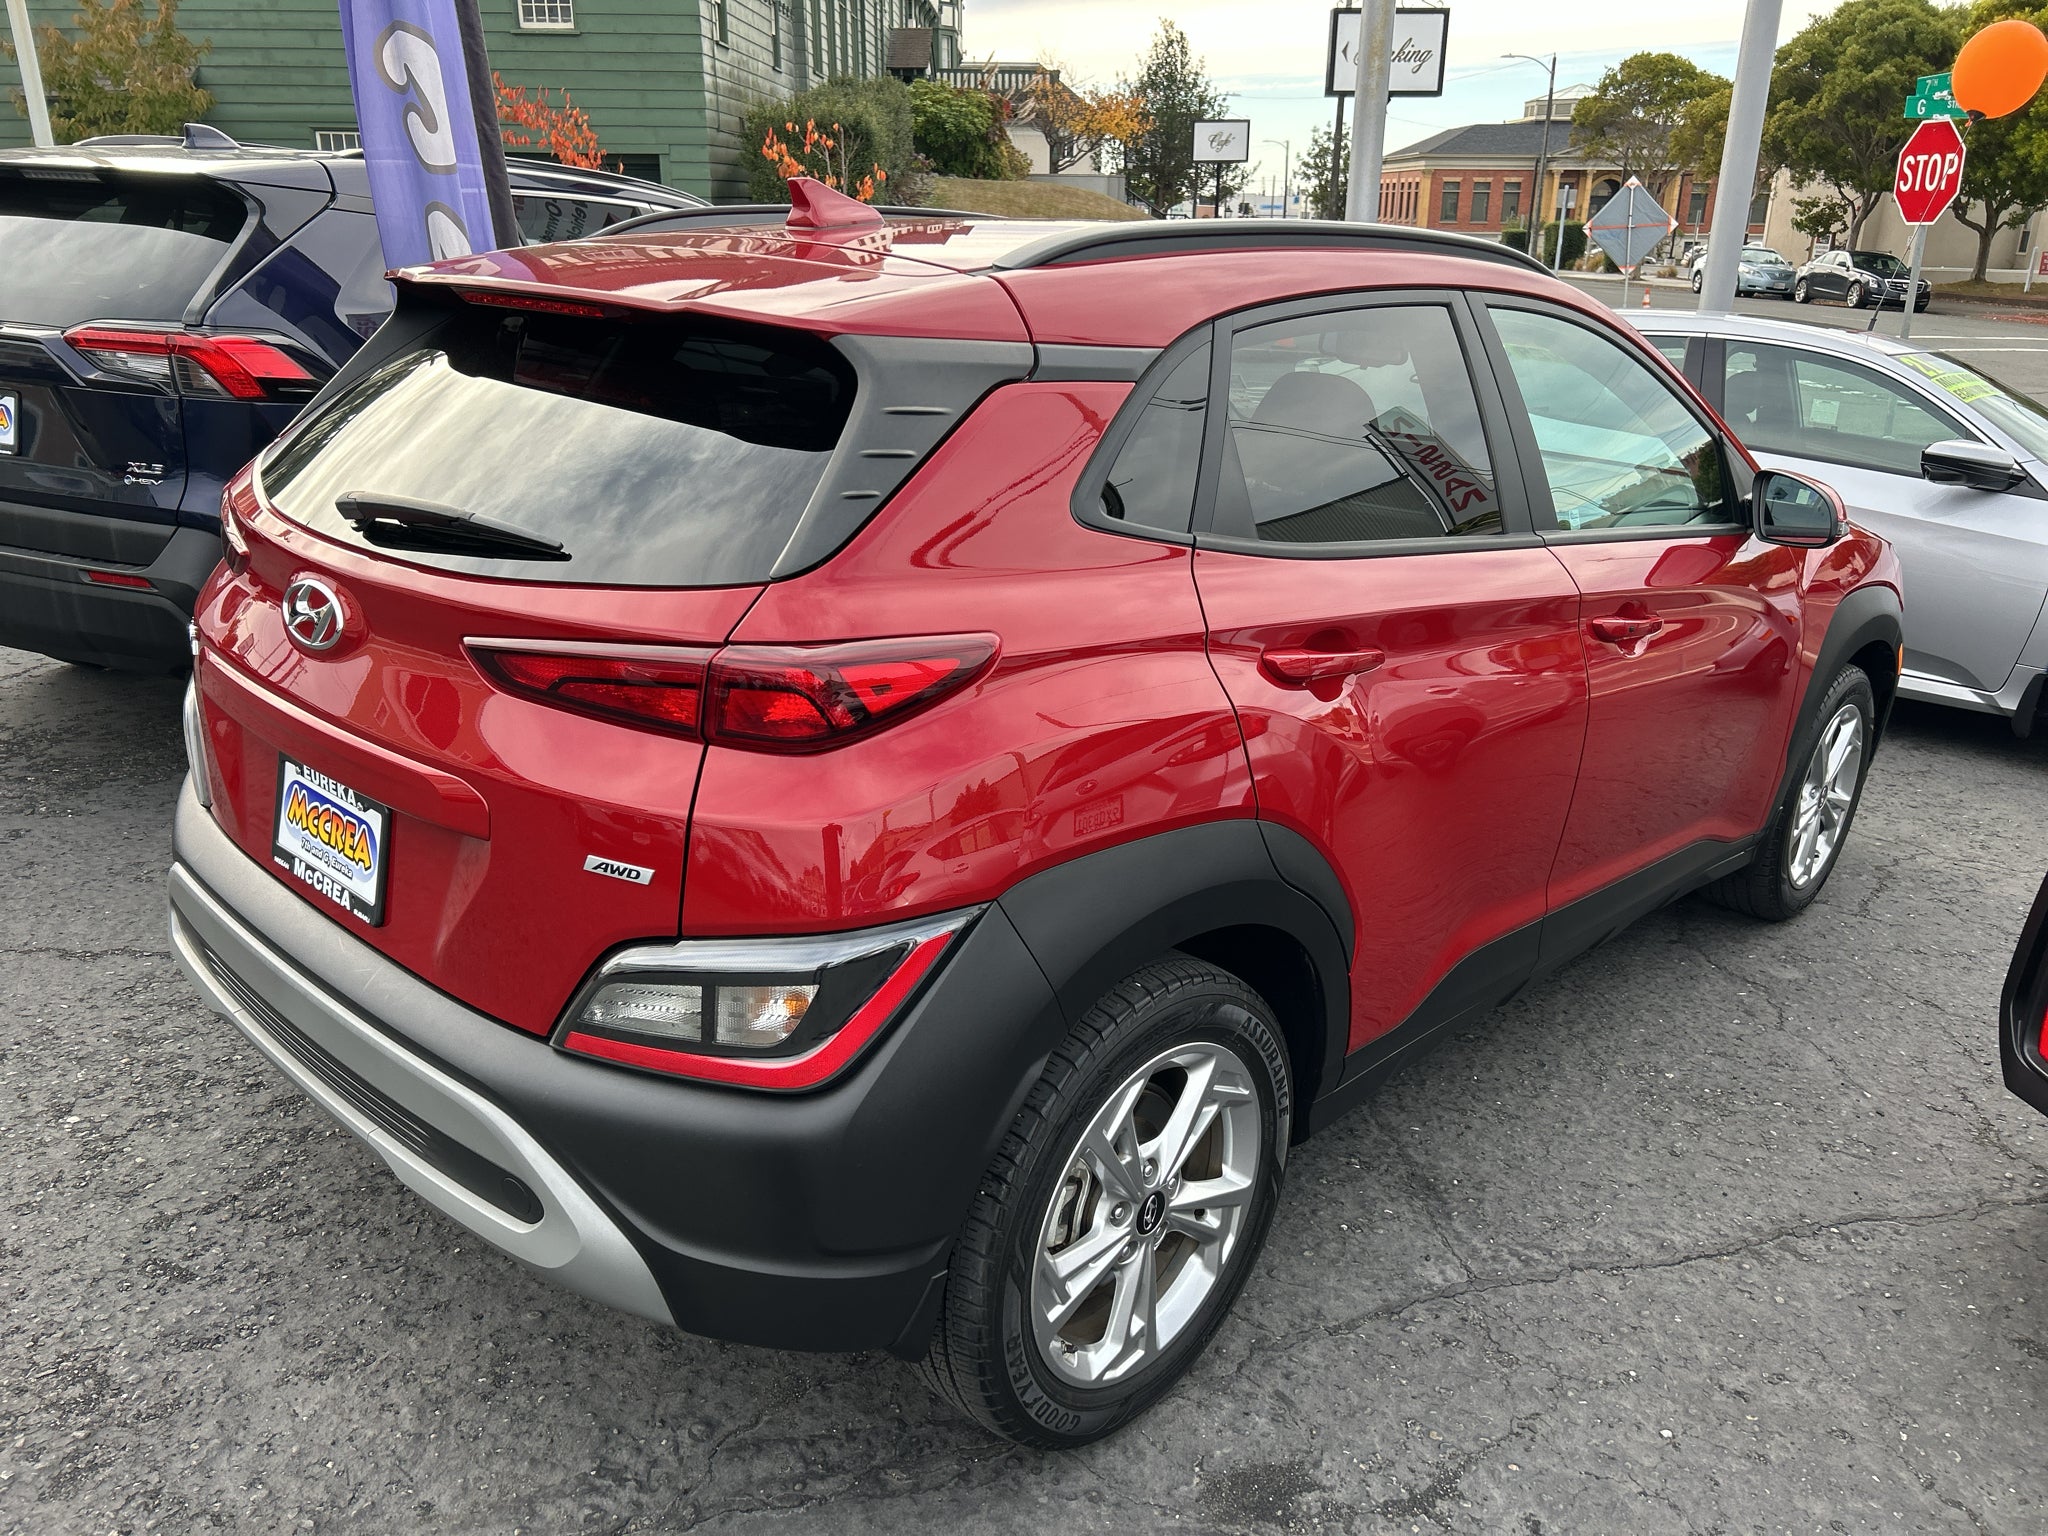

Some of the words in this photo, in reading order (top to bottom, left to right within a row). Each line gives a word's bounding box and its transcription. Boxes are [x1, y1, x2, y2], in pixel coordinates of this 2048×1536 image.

[1925, 78, 1939, 94] 7TH
[1917, 99, 1927, 115] G
[1899, 153, 1959, 192] STOP
[303, 764, 356, 807] EUREKA
[301, 836, 311, 853] 7th
[311, 846, 323, 861] and
[331, 856, 353, 880] Eureka
[592, 862, 641, 880] AWD
[293, 857, 351, 910] McCREA
[1241, 1016, 1289, 1119] ASSURANCE
